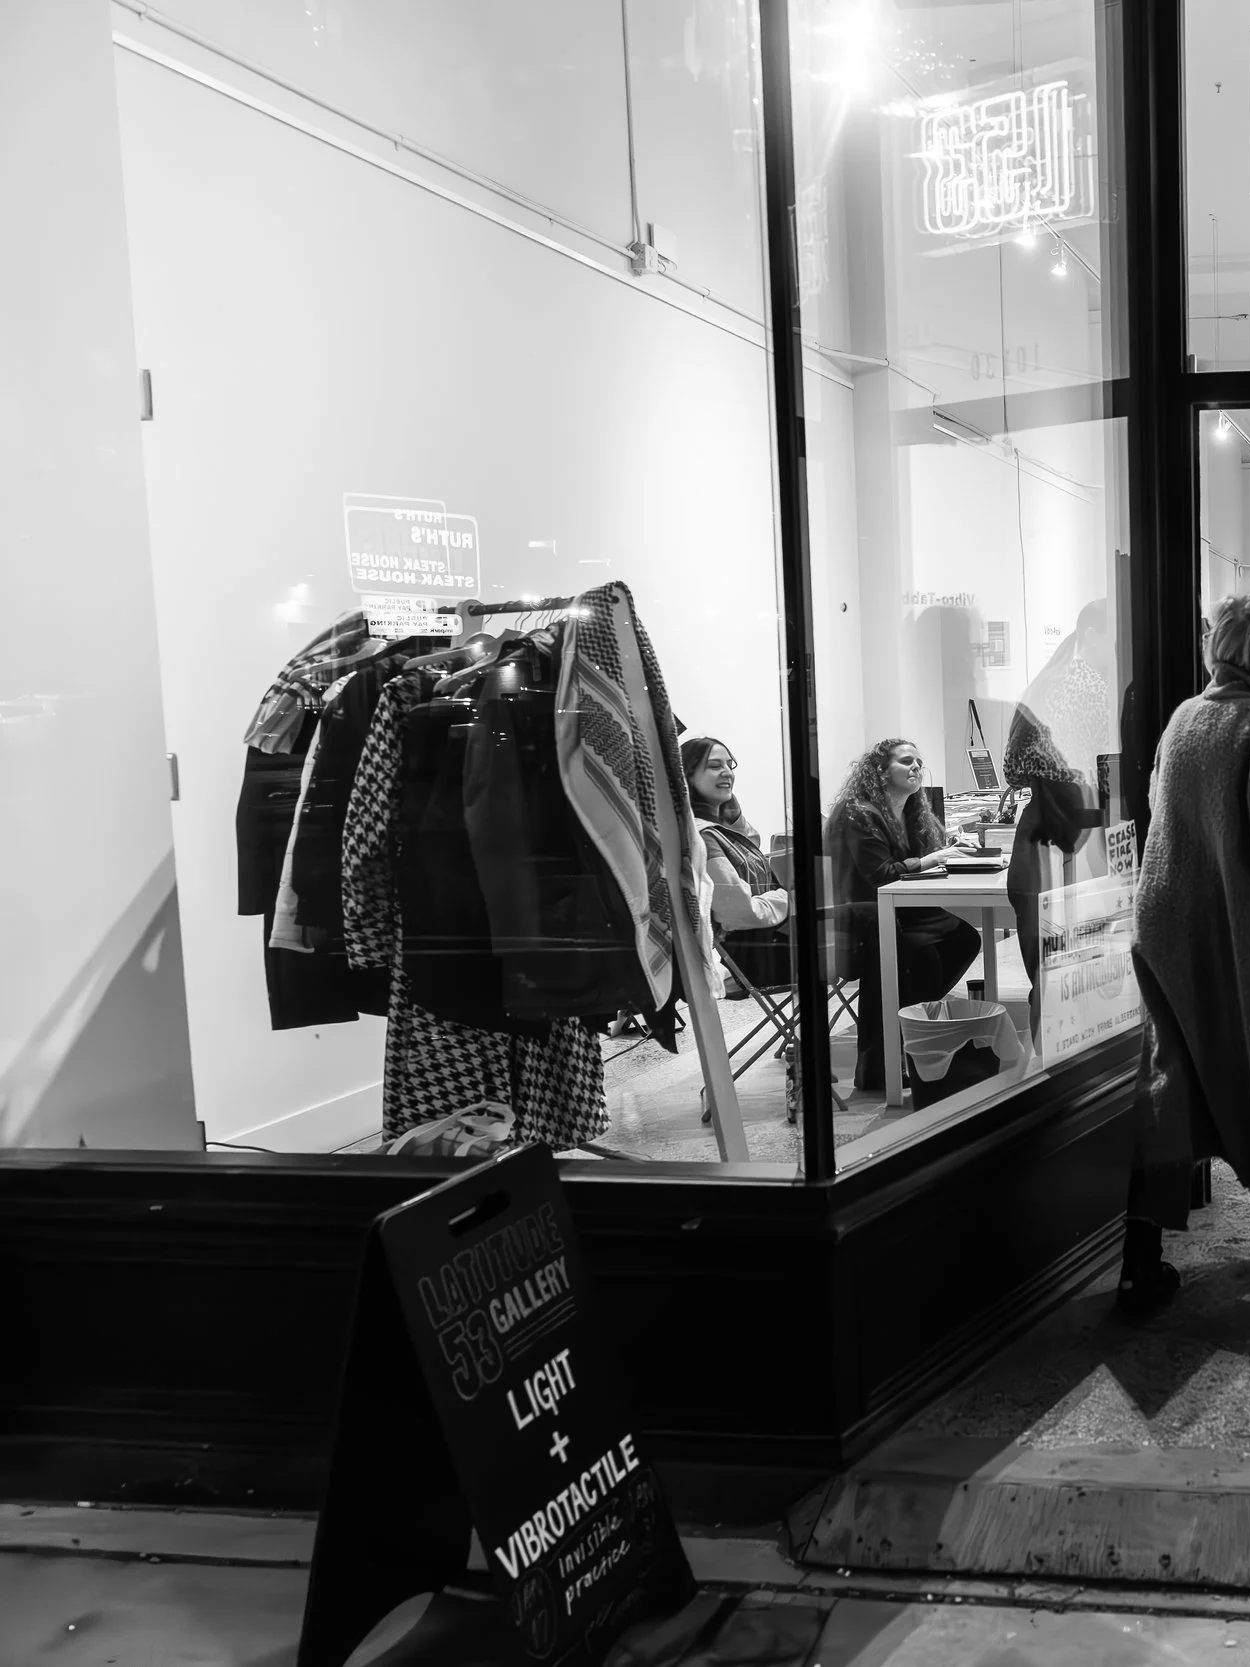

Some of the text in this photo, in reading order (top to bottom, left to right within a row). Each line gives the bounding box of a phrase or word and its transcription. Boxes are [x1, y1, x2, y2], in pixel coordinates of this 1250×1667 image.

[1108, 823, 1135, 847] CEASE
[1110, 841, 1132, 861] FIRE
[1110, 854, 1133, 877] NOW
[417, 1203, 564, 1330] LATITUDE
[489, 1255, 570, 1334] GALLERY
[438, 1309, 503, 1400] 53
[507, 1348, 576, 1430] LIGHT
[494, 1433, 640, 1579] VIBROTACTILE
